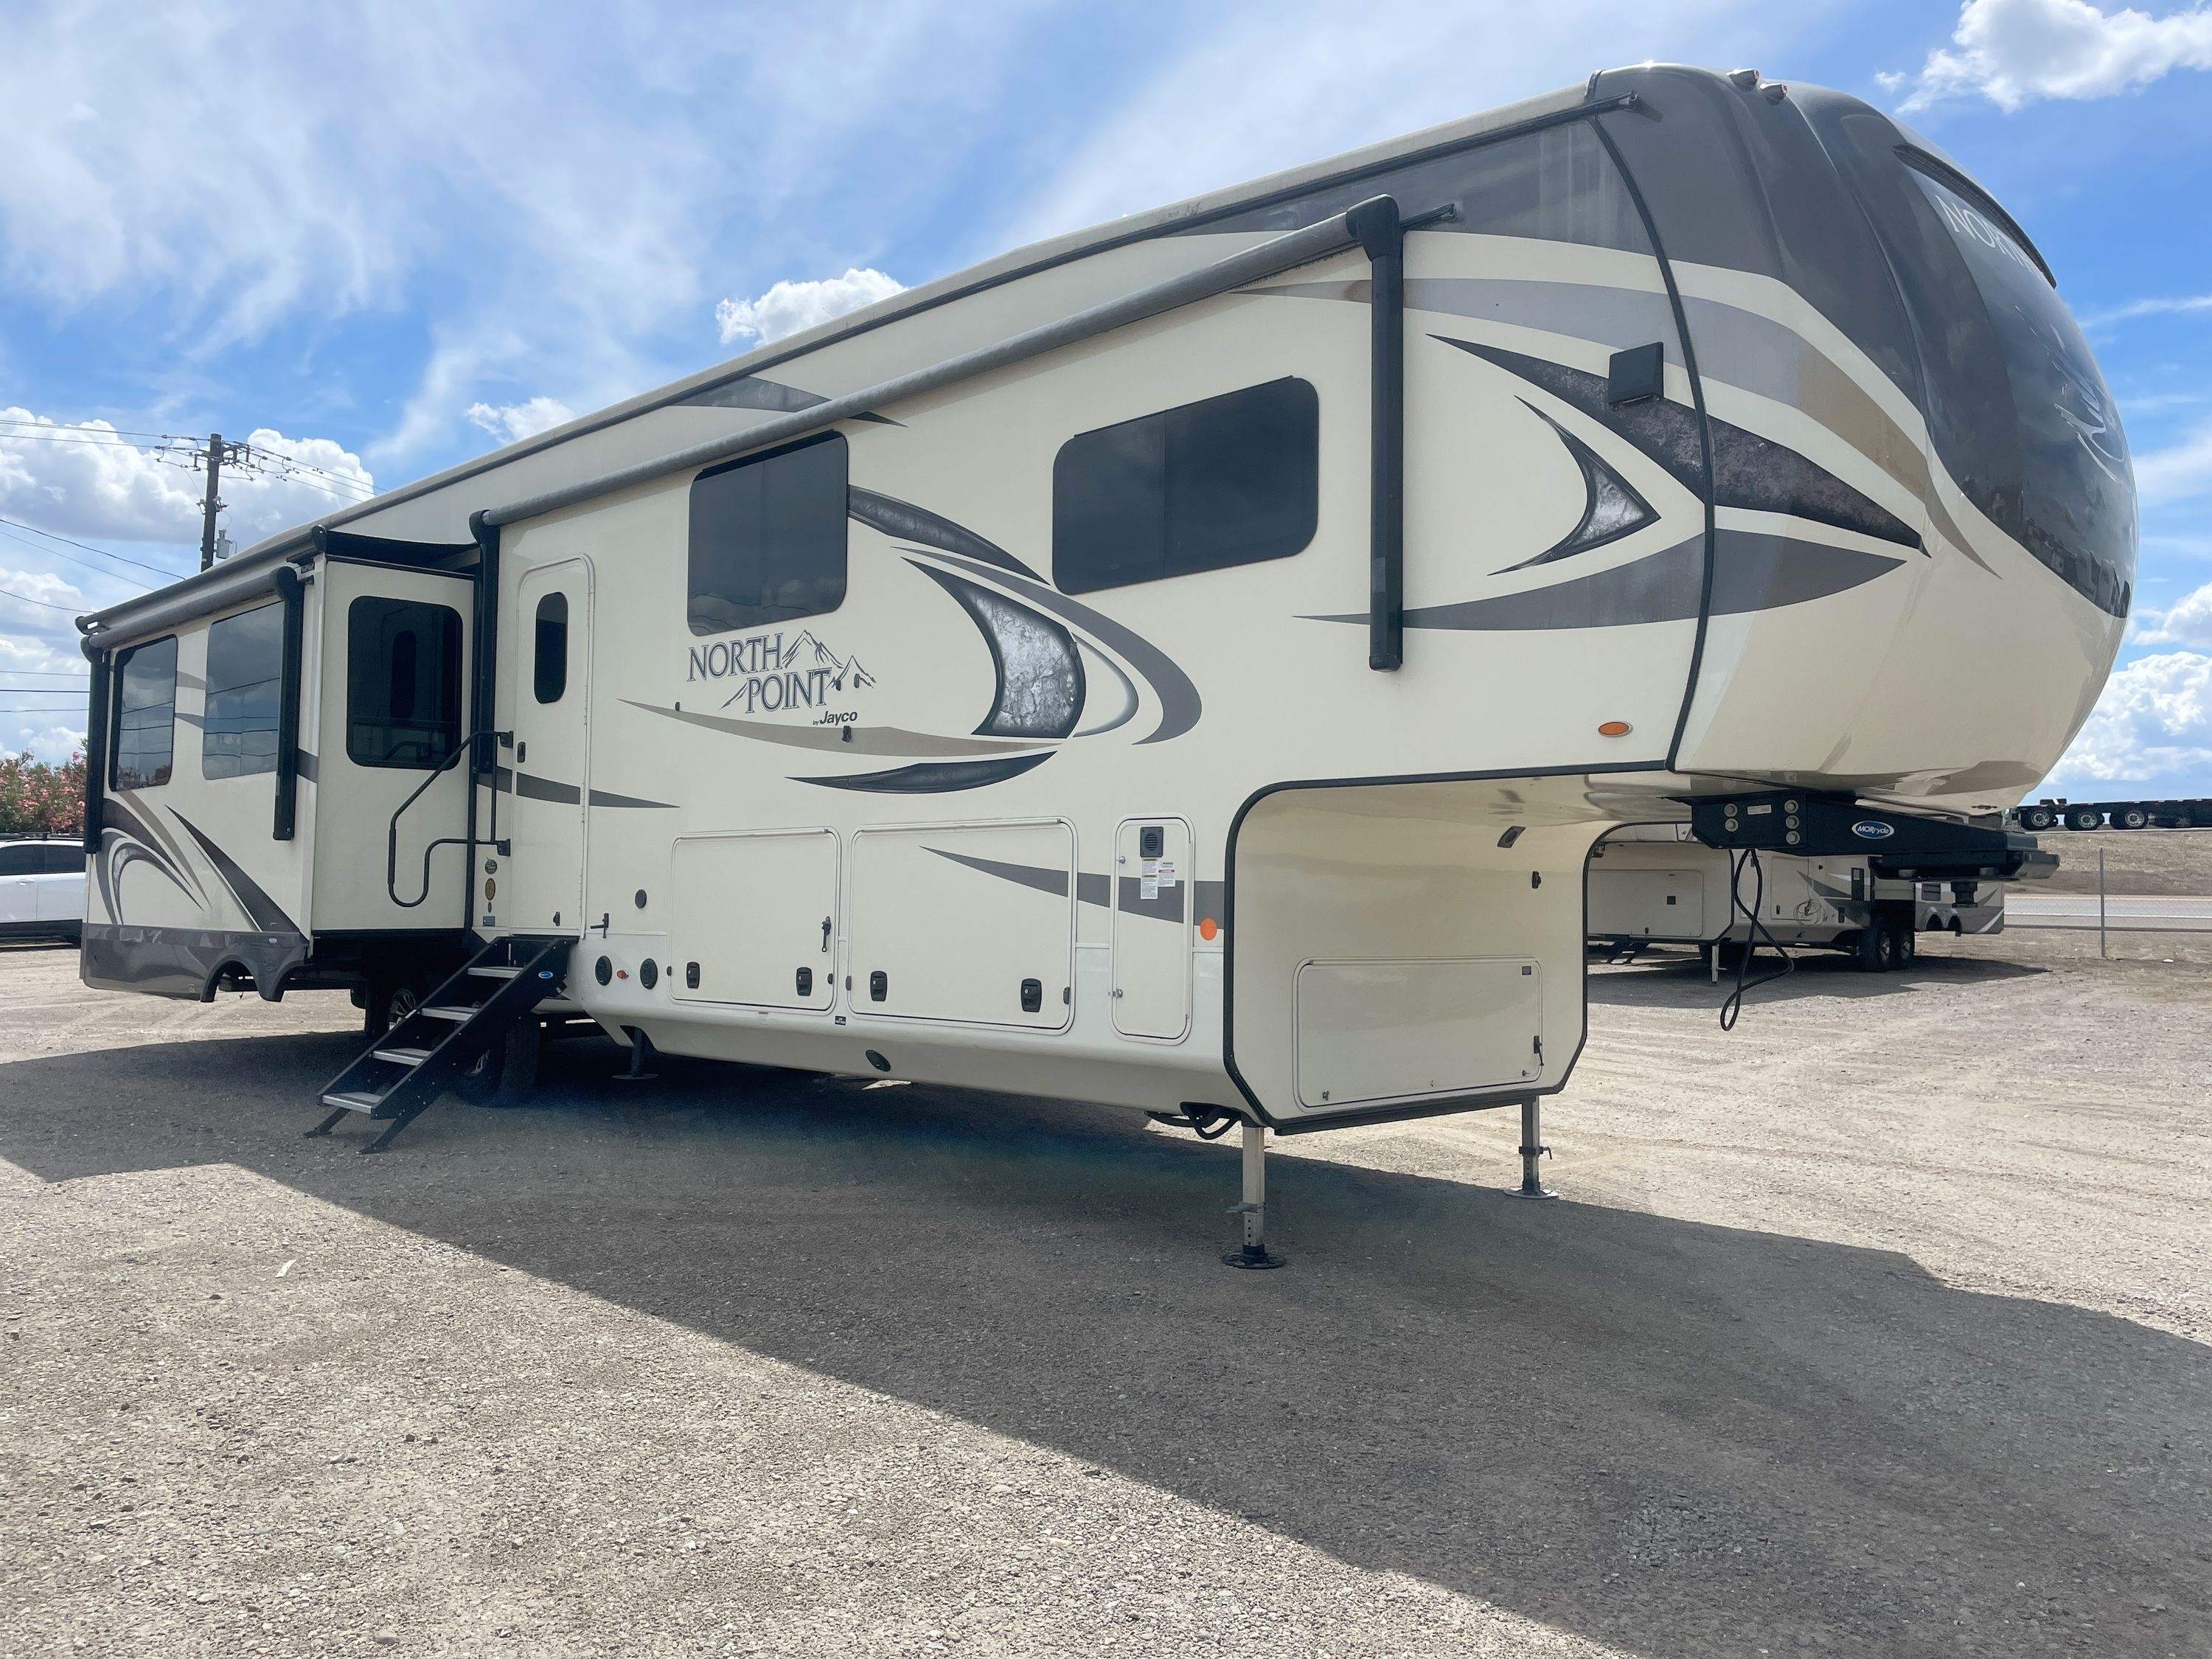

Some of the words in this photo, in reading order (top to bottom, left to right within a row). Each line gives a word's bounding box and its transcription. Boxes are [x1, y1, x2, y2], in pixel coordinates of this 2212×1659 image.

[686, 632, 784, 682] NORTH
[745, 667, 832, 714] POINT
[819, 711, 858, 726] Jayco
[1857, 825, 1889, 835] MORryde
